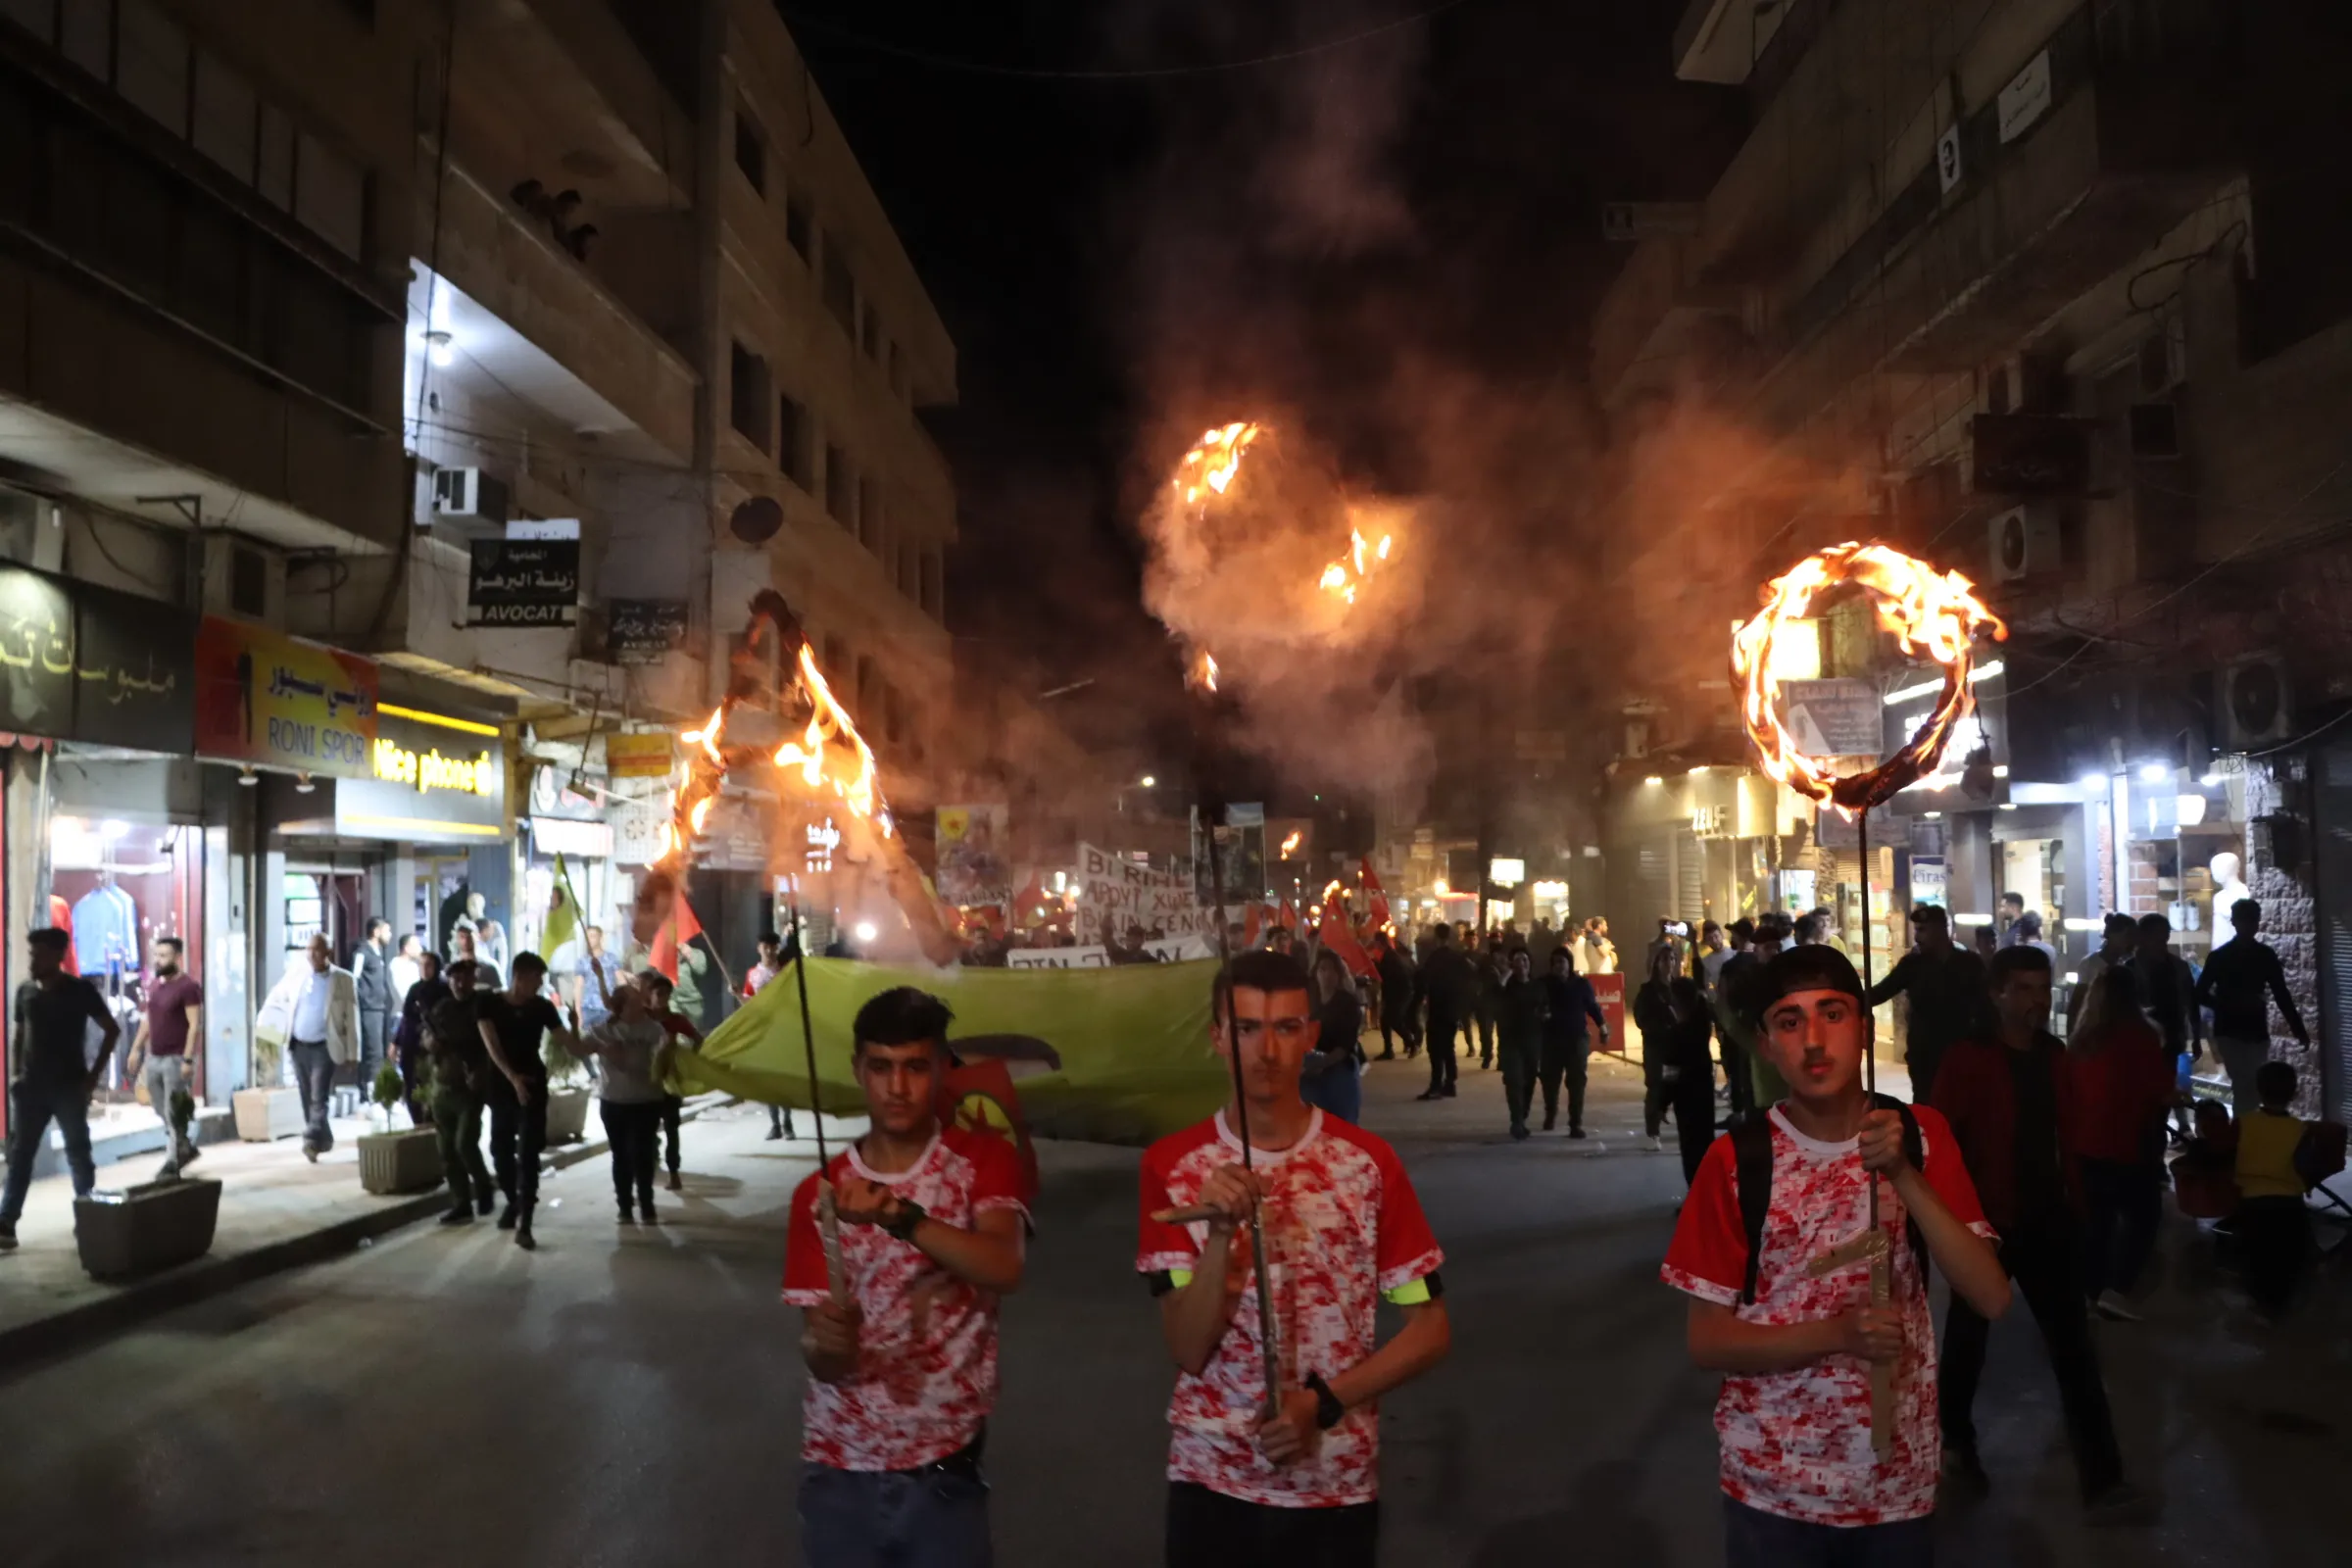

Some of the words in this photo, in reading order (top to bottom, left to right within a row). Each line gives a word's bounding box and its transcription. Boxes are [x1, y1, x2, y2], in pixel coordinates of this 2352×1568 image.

[534, 569, 575, 592] زينة
[485, 604, 561, 621] AVOCAT
[269, 716, 316, 757] RONI
[321, 728, 366, 764] SPOR
[373, 738, 417, 784] Nice
[419, 748, 473, 795] phone
[1087, 850, 1112, 877] BI
